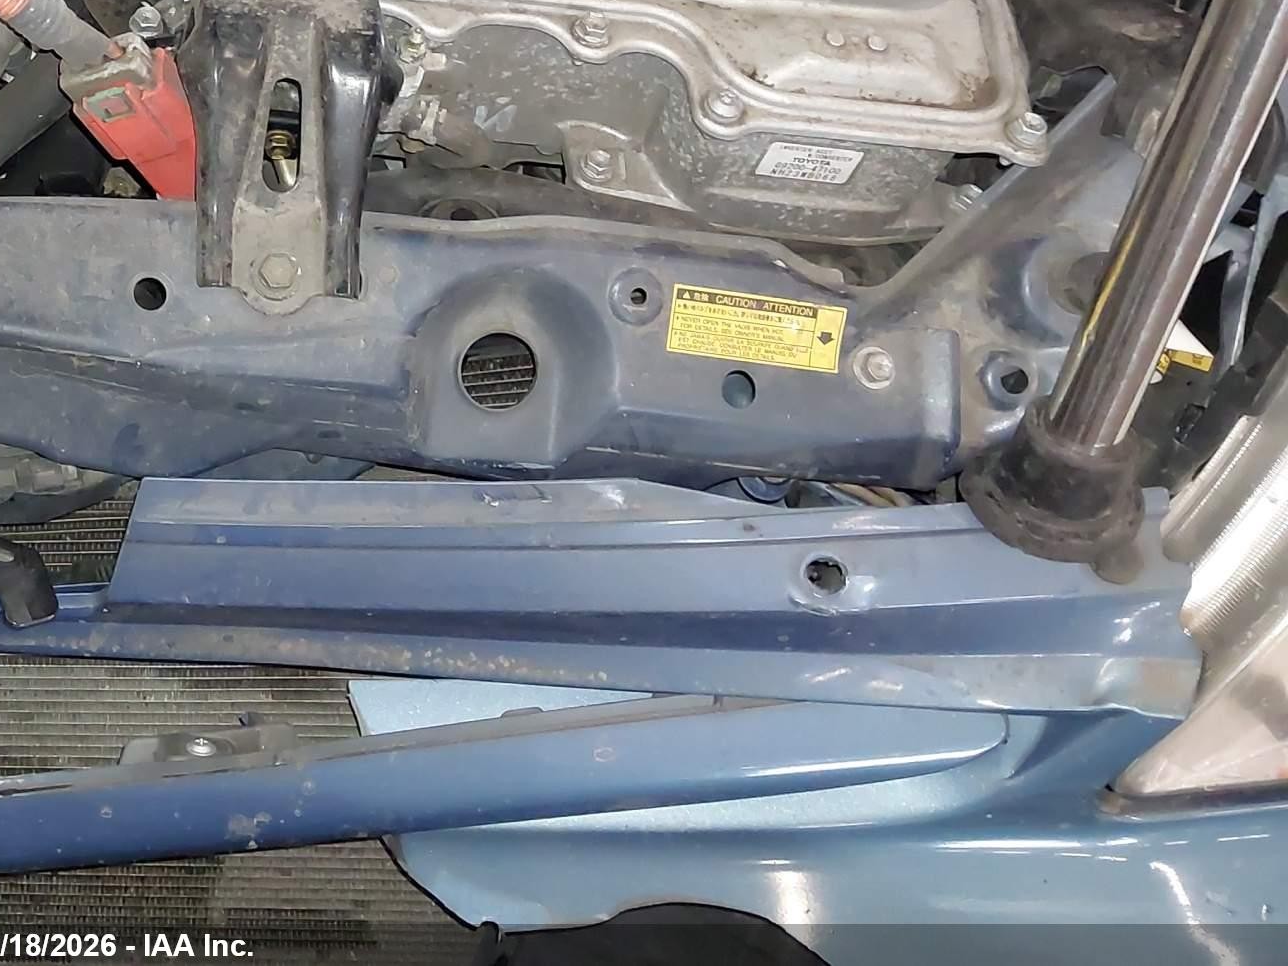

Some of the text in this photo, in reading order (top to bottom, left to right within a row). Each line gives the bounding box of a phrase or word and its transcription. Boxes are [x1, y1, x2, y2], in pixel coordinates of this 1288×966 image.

[793, 157, 831, 166] TOYOTA
[715, 295, 758, 309] CAUTION
[762, 303, 814, 317] ATTENTION
